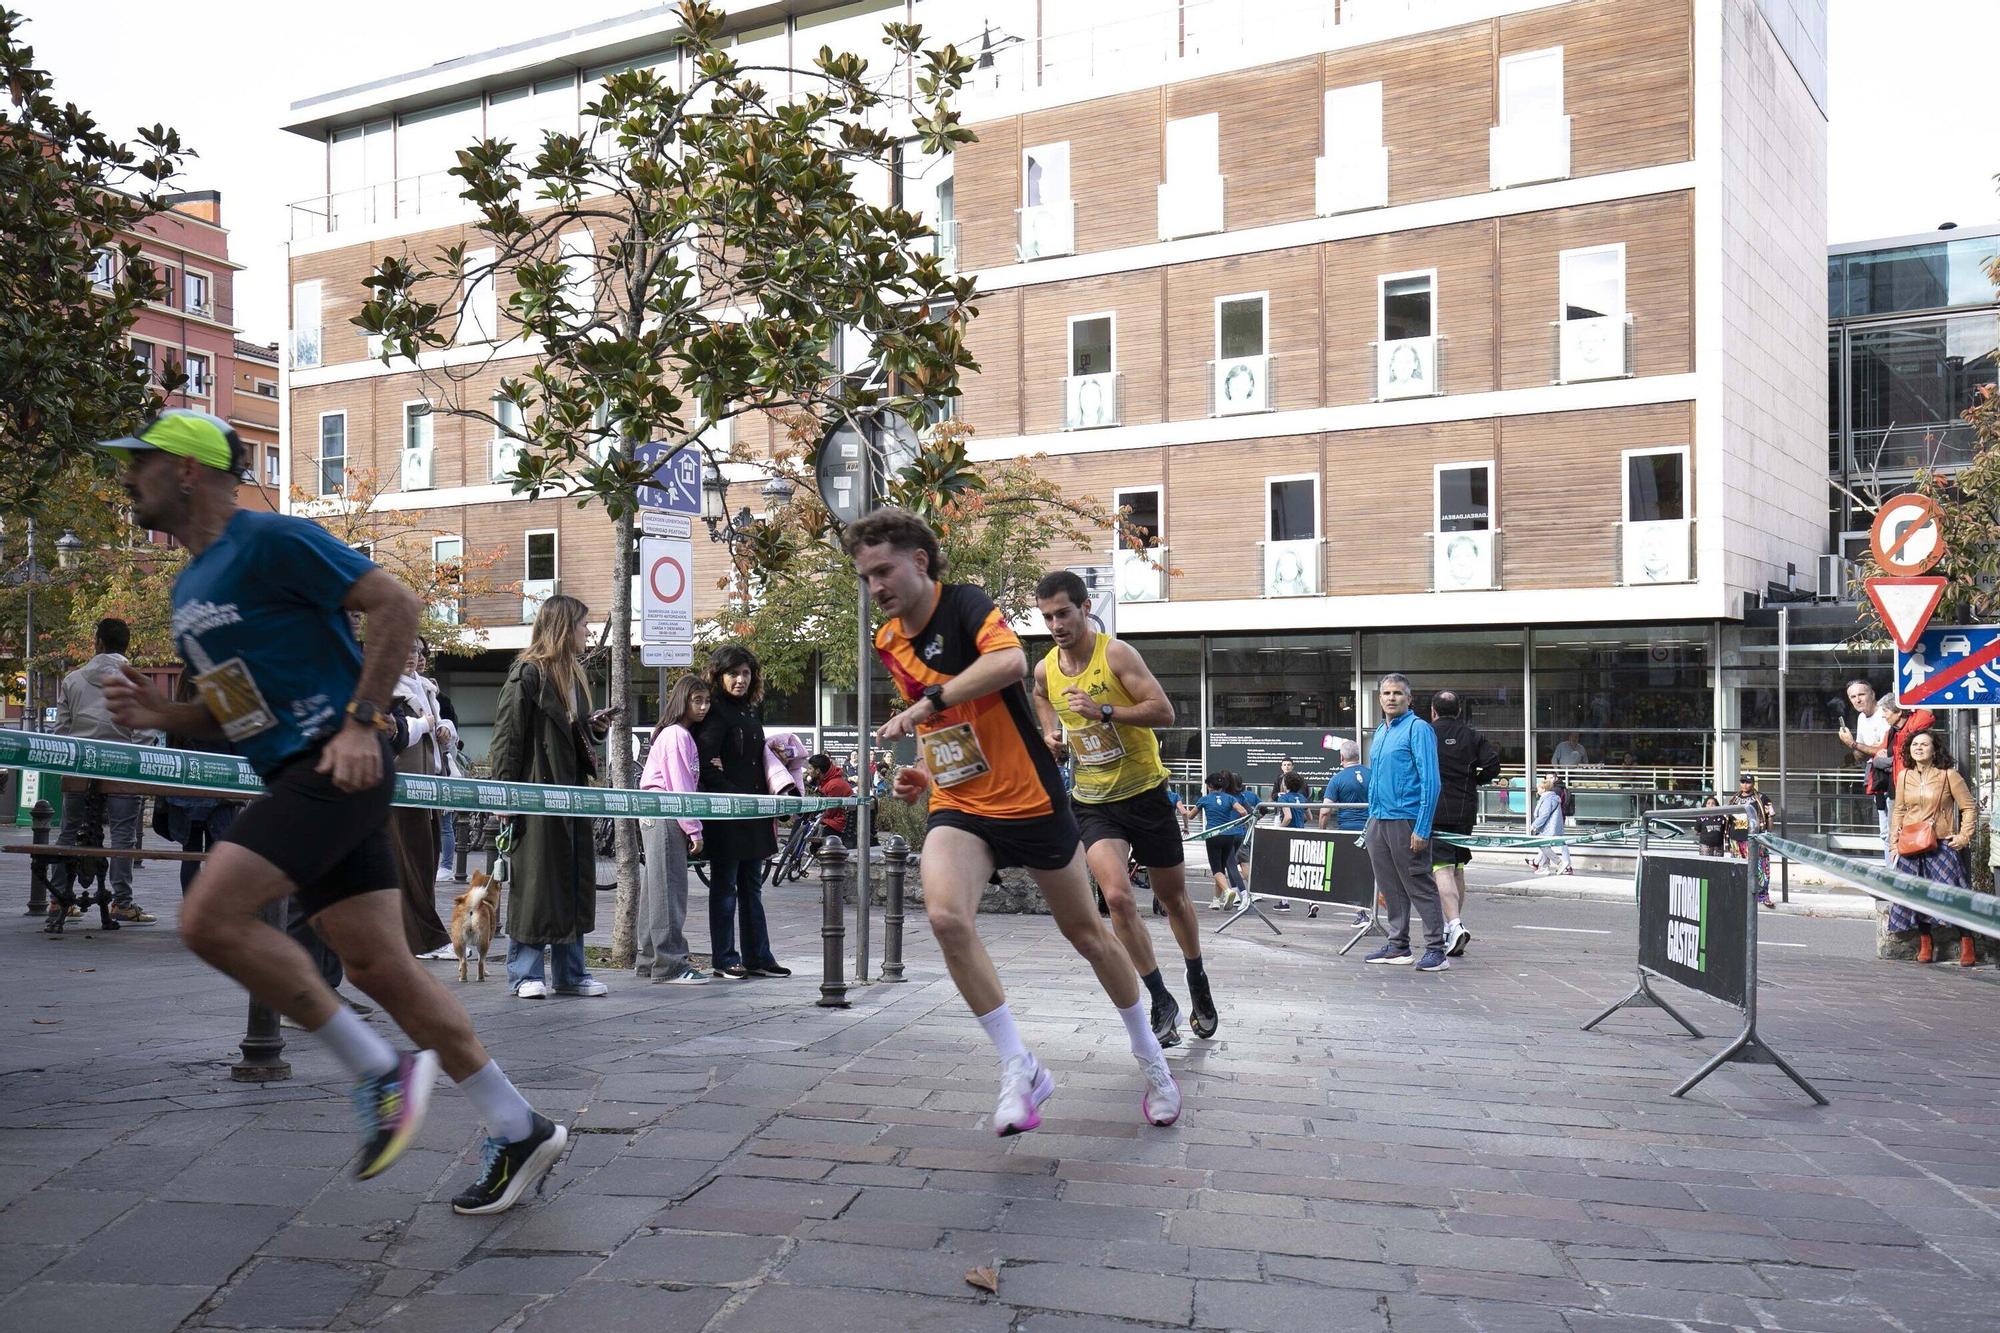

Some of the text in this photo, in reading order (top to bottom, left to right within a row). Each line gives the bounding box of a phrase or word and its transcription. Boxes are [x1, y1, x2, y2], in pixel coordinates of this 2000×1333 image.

[28, 737, 69, 752] VITORIA
[931, 740, 964, 767] 205
[1081, 735, 1101, 751] 50
[139, 751, 175, 765] VITORIA
[1290, 838, 1326, 865] VITORIA
[1669, 873, 1700, 922] VITORIA
